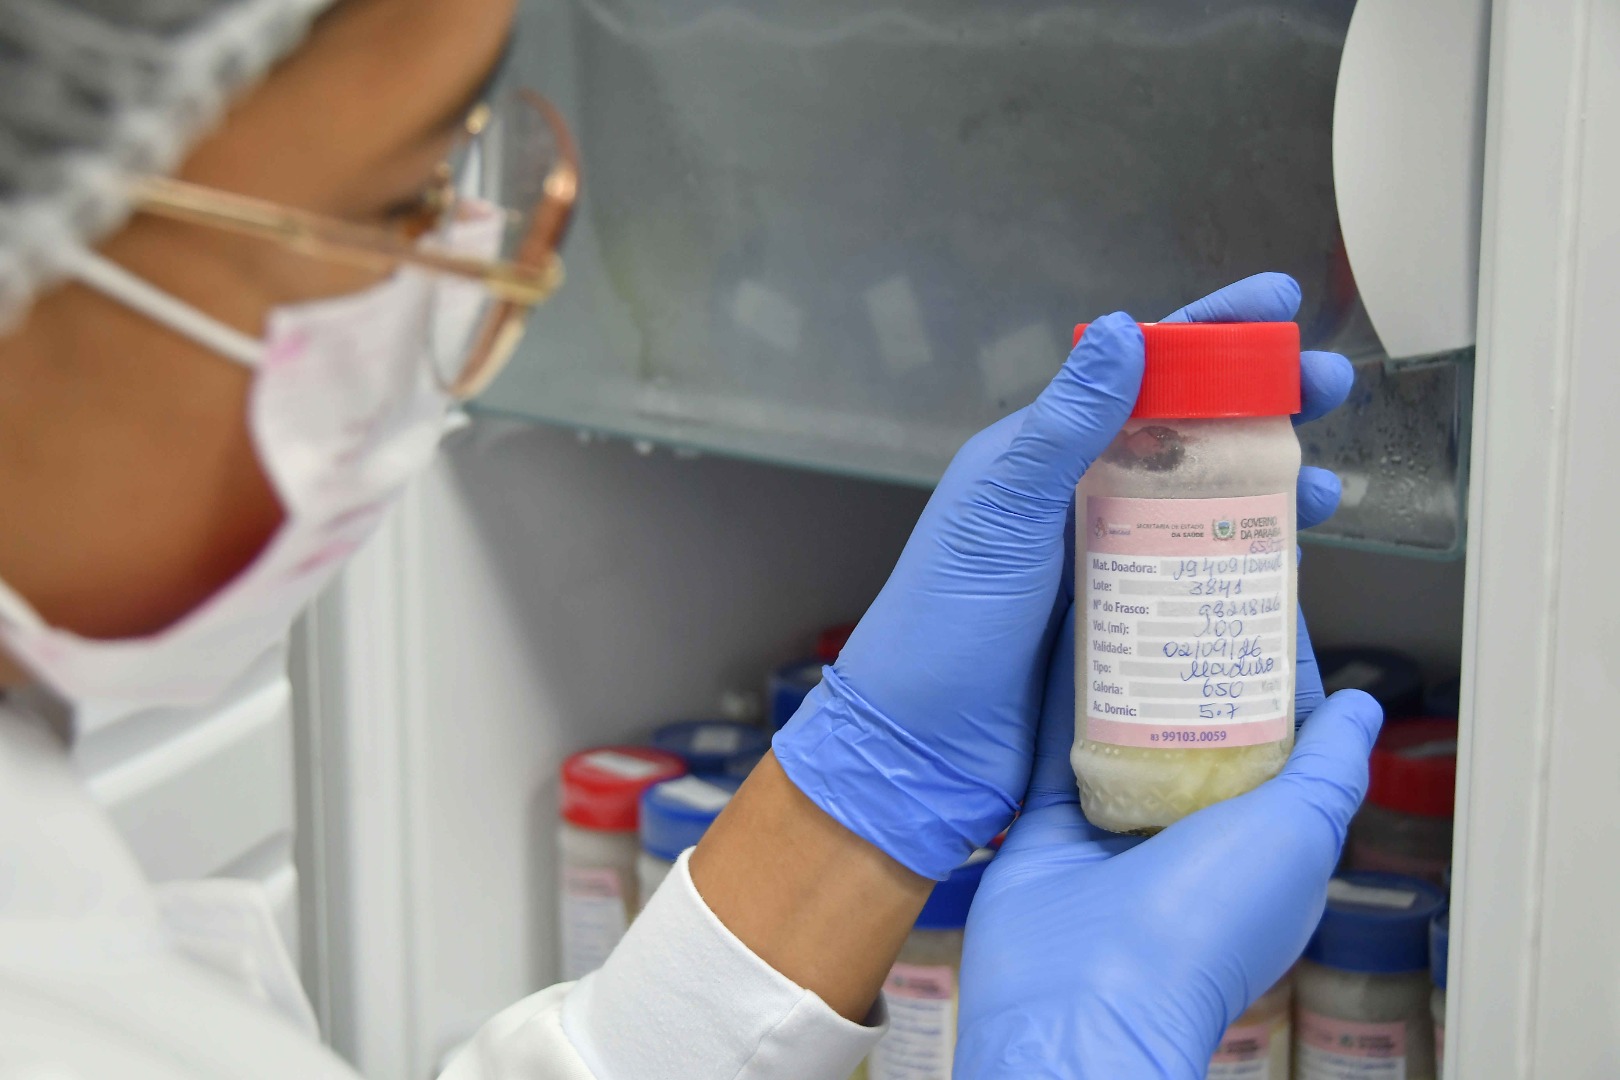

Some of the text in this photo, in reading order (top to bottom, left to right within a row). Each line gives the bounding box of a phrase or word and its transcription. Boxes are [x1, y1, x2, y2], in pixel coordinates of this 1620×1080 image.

[1240, 516, 1278, 528] GOVERNO
[1240, 529, 1253, 540] DA
[1092, 558, 1157, 574] Mat. Doadora:
[1093, 579, 1112, 592] Lote:
[1103, 600, 1113, 612] do
[1115, 602, 1150, 615] Frasco:
[1093, 620, 1107, 633] Vol.
[1093, 640, 1132, 655] Validade:
[1093, 660, 1112, 674] Tipo:
[1093, 680, 1123, 695] Caloria:
[1202, 677, 1244, 699] 650
[1150, 731, 1227, 742] 83 99103.0059
